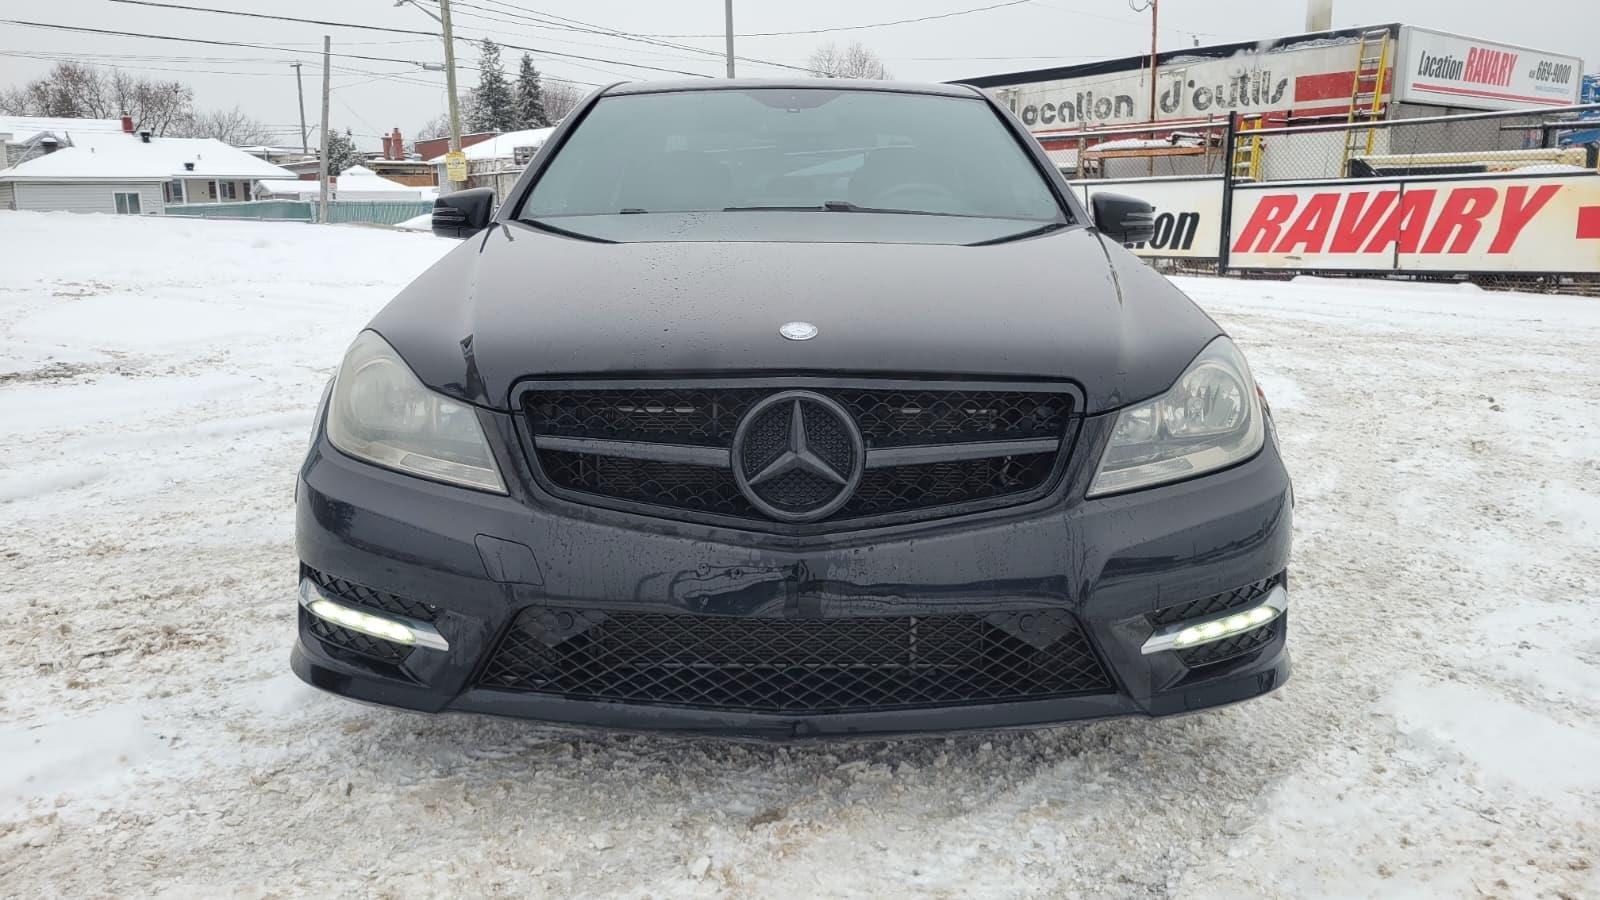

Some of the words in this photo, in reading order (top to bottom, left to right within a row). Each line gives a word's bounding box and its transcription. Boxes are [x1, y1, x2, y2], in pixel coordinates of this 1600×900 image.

[1417, 50, 1464, 81] Location
[1463, 47, 1518, 87] RAVARY
[1535, 60, 1572, 85] 669-9000
[1159, 68, 1289, 113] d'outils
[1231, 184, 1563, 254] RAVARY
